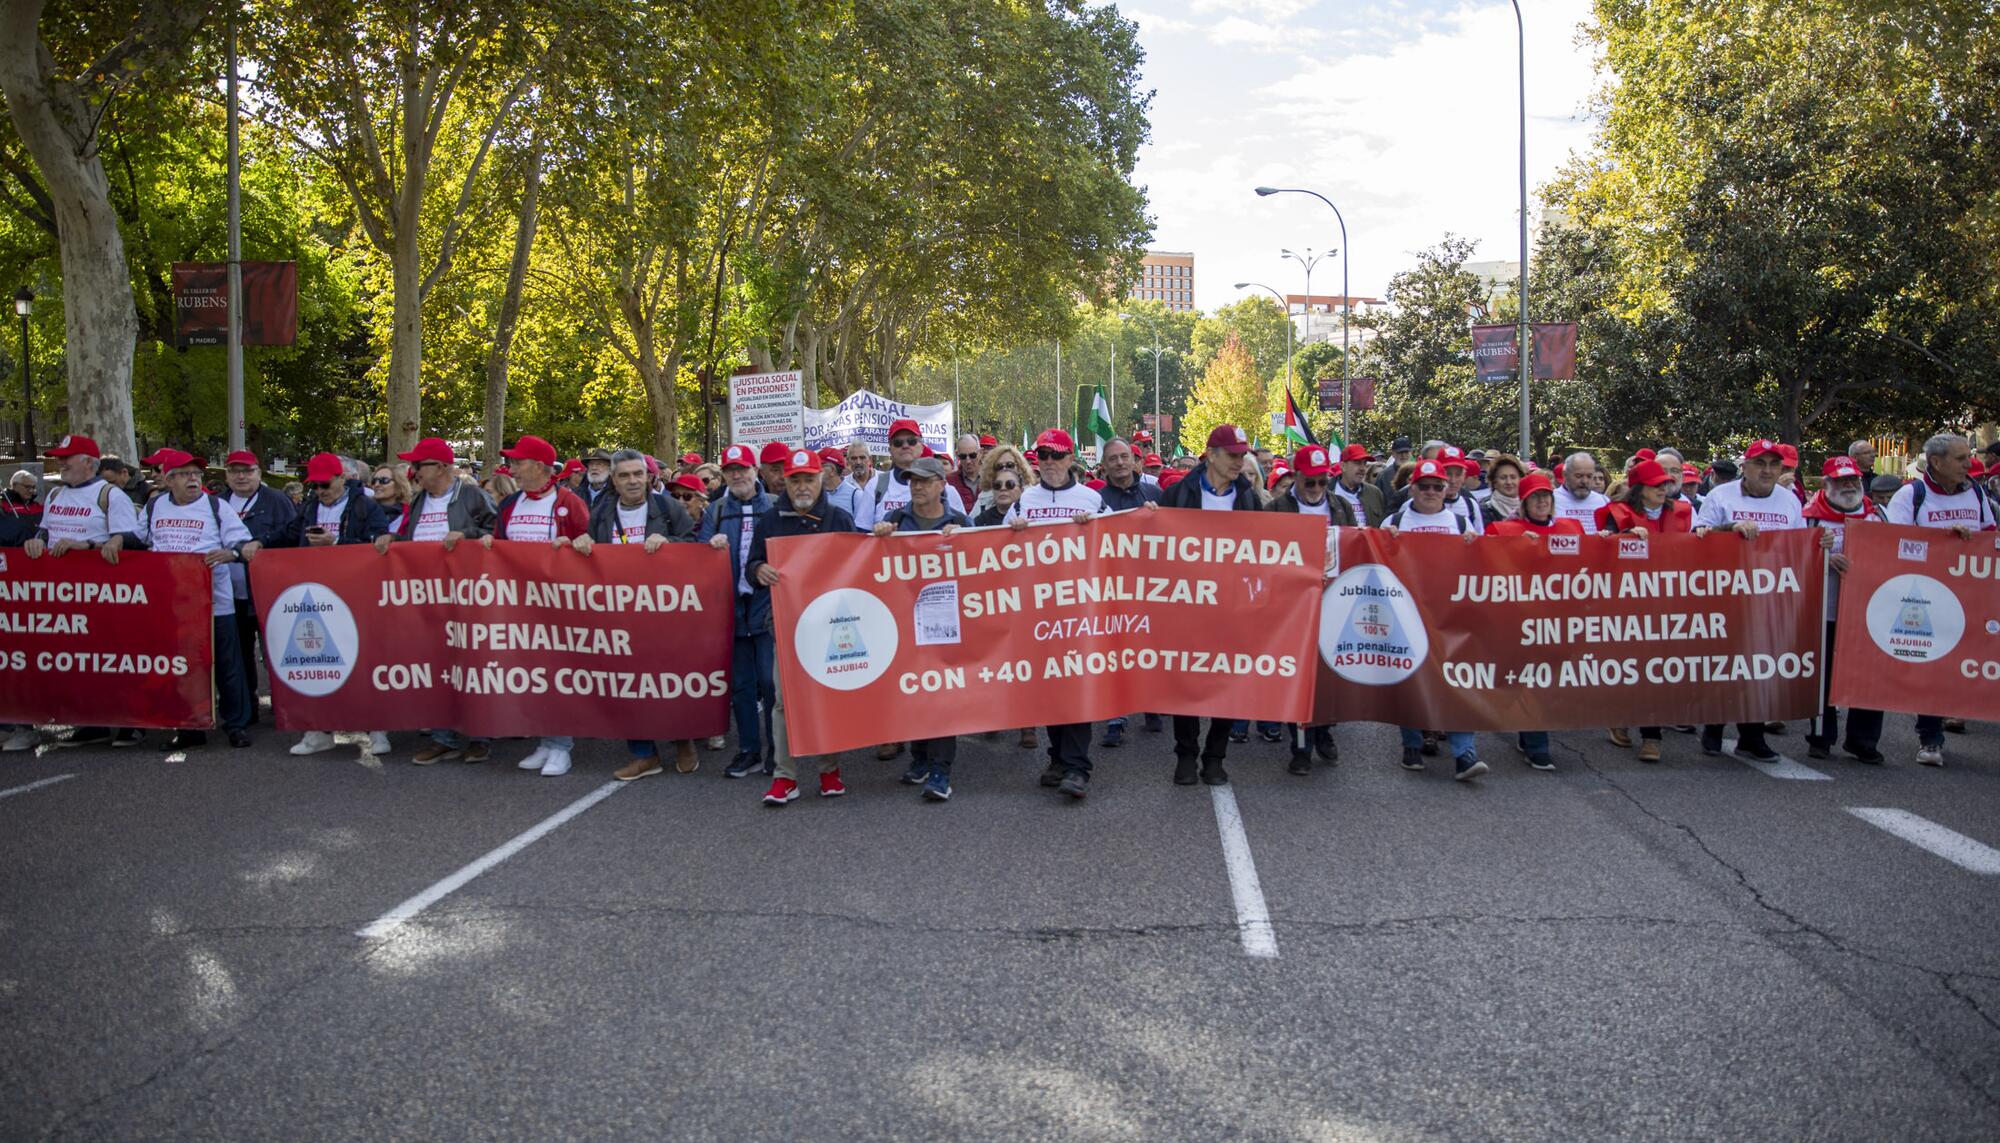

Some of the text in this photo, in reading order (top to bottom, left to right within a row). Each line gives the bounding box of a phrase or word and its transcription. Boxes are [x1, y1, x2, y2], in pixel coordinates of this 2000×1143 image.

[177, 296, 228, 308] RUBENS
[1476, 347, 1517, 357] RUBENS
[772, 373, 798, 384] SOCIAL
[736, 388, 746, 396] EN
[748, 383, 788, 395] PENSIONES
[840, 393, 909, 418] ARAHAL
[803, 424, 824, 438] POR
[919, 422, 947, 434] GNAS
[49, 504, 92, 517] ASJUBI40
[1735, 511, 1785, 522] ASJUBI40
[158, 519, 202, 528] ASJUBI40
[874, 533, 1304, 583] JUBILACIÓN ANTICIPADA
[1948, 554, 2000, 580] JU
[0, 581, 148, 604] ANTICIPADA
[378, 573, 703, 612] JUBILACIÓN ANTICIPADA
[1340, 585, 1403, 597] Jubilación
[1450, 567, 1800, 602] JUBILACIÓN ANTICIPADA
[963, 575, 1219, 618] SIN PENALIZAR
[283, 602, 333, 613] Jubilación
[0, 612, 89, 634] ALIZAR
[1034, 614, 1151, 641] CATALUNYA
[1520, 612, 1728, 645] SIN PENALIZAR
[445, 620, 633, 655] SIN PENALIZAR
[1889, 637, 1932, 648] ASJUBI40
[1337, 641, 1408, 654] sin penalizar
[37, 652, 188, 675] COTIZADOS
[285, 653, 340, 665] sin penalizar
[826, 662, 869, 674] ASJUBI40
[1334, 653, 1413, 670] ASJUBI40
[288, 670, 341, 680] ASJUBI40
[899, 648, 1297, 695] CON +40 AÑOS COTIZADOS
[1442, 650, 1815, 689] CON +40 AÑOS COTIZADOS
[1961, 659, 2000, 680] CO
[372, 661, 728, 699] CON +40 AÑOS COTIZADOS
